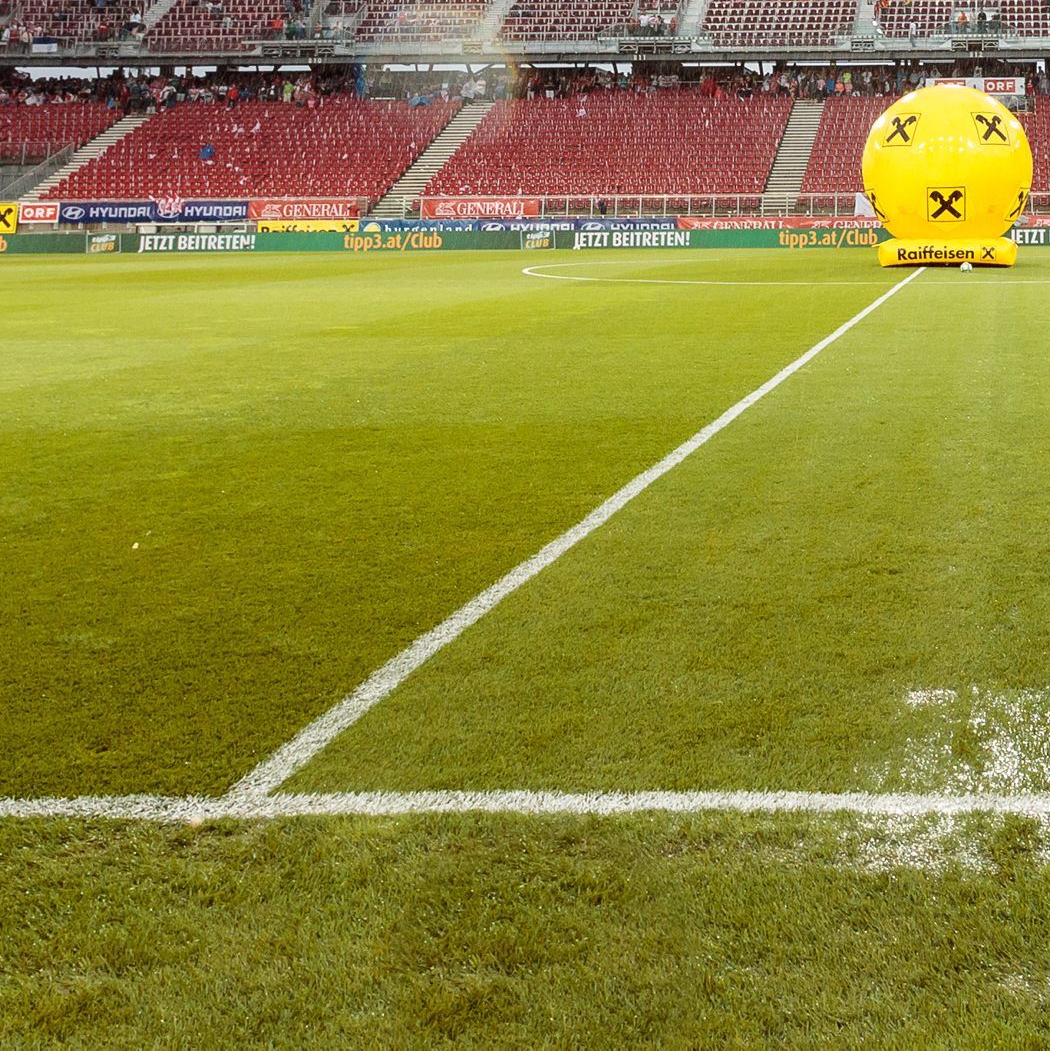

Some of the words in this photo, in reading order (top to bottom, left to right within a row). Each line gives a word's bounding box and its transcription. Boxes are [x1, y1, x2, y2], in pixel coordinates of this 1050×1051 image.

[986, 81, 1014, 90] ORF
[24, 207, 56, 218] ORF
[90, 206, 150, 217] HYUNDAI
[184, 206, 246, 217] HYUNDAI
[283, 204, 350, 216] GENERALI
[457, 202, 525, 215] GENERALI
[138, 235, 175, 253] JETZT
[178, 234, 256, 250] BEITRETEN!
[343, 232, 442, 251] tipp3.at/Club
[573, 232, 610, 249] JETZT
[612, 232, 691, 247] BEITRETEN!
[779, 229, 878, 248] tipp3.at/Club
[897, 246, 975, 261] Raiffeisen
